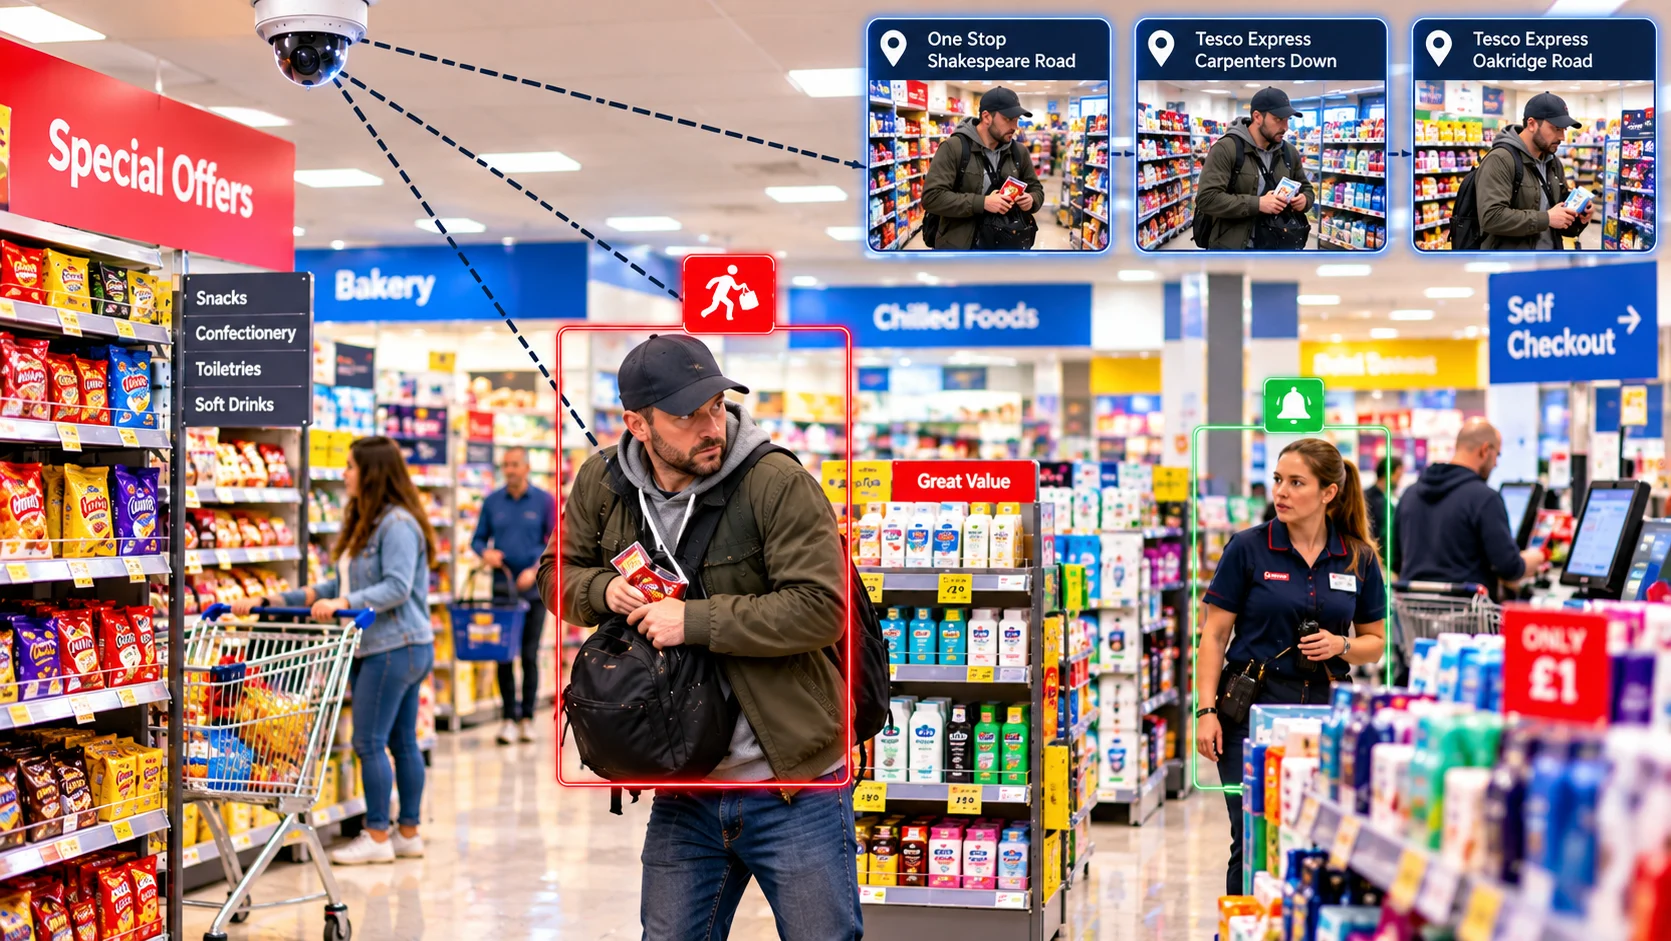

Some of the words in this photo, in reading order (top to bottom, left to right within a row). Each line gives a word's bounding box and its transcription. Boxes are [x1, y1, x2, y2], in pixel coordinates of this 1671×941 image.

[48, 119, 163, 195] Special
[172, 155, 253, 218] Offers
[197, 290, 247, 305] Snacks
[336, 268, 435, 306] Bakery
[874, 303, 959, 330] Chilled
[964, 302, 1039, 329] Foods
[1508, 293, 1554, 324] Self
[196, 325, 296, 343] Confectionery
[1508, 327, 1615, 359] Checkout
[196, 361, 261, 376] Toiletries
[196, 396, 225, 411] Soft
[229, 396, 274, 411] Drinks
[918, 473, 962, 488] Great
[966, 473, 1010, 489] Value
[1522, 624, 1587, 654] ONLY
[1529, 656, 1578, 705] £1
